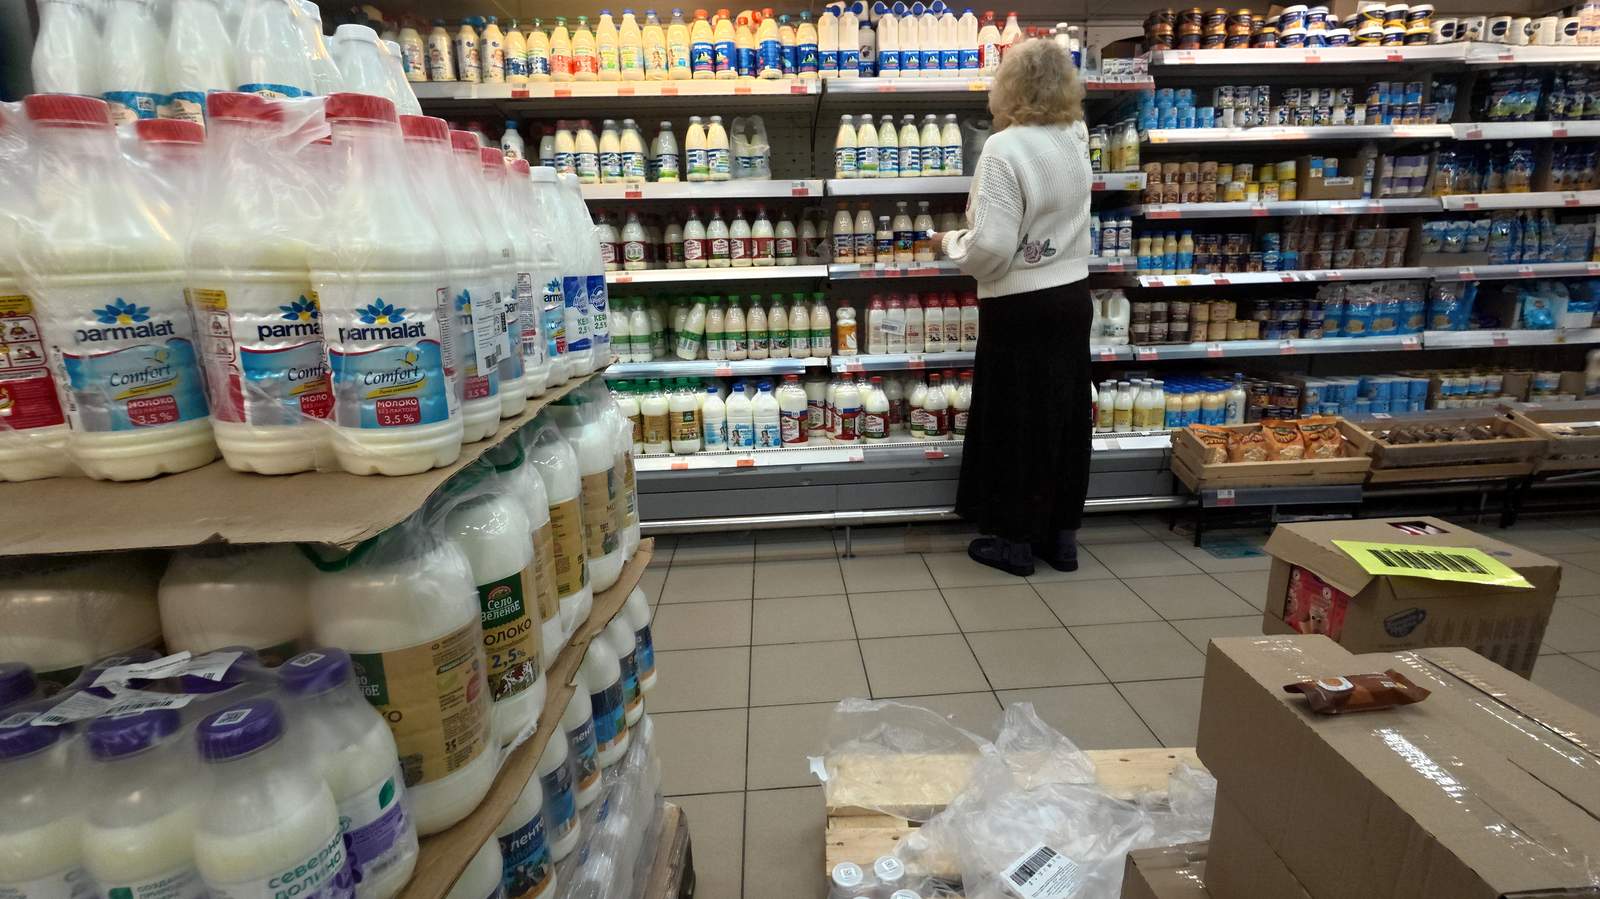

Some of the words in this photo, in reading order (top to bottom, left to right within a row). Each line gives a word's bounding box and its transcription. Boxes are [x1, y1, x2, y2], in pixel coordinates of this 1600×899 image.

[74, 320, 175, 345] parmalat
[257, 322, 322, 341] parma
[338, 321, 426, 343] parmalat
[110, 364, 171, 387] Comfort
[287, 362, 324, 381] Comf
[364, 366, 418, 386] Comfort
[301, 394, 327, 403] МОЛО
[377, 399, 417, 408] МОЛОКО
[483, 617, 532, 646] ОЛОКО
